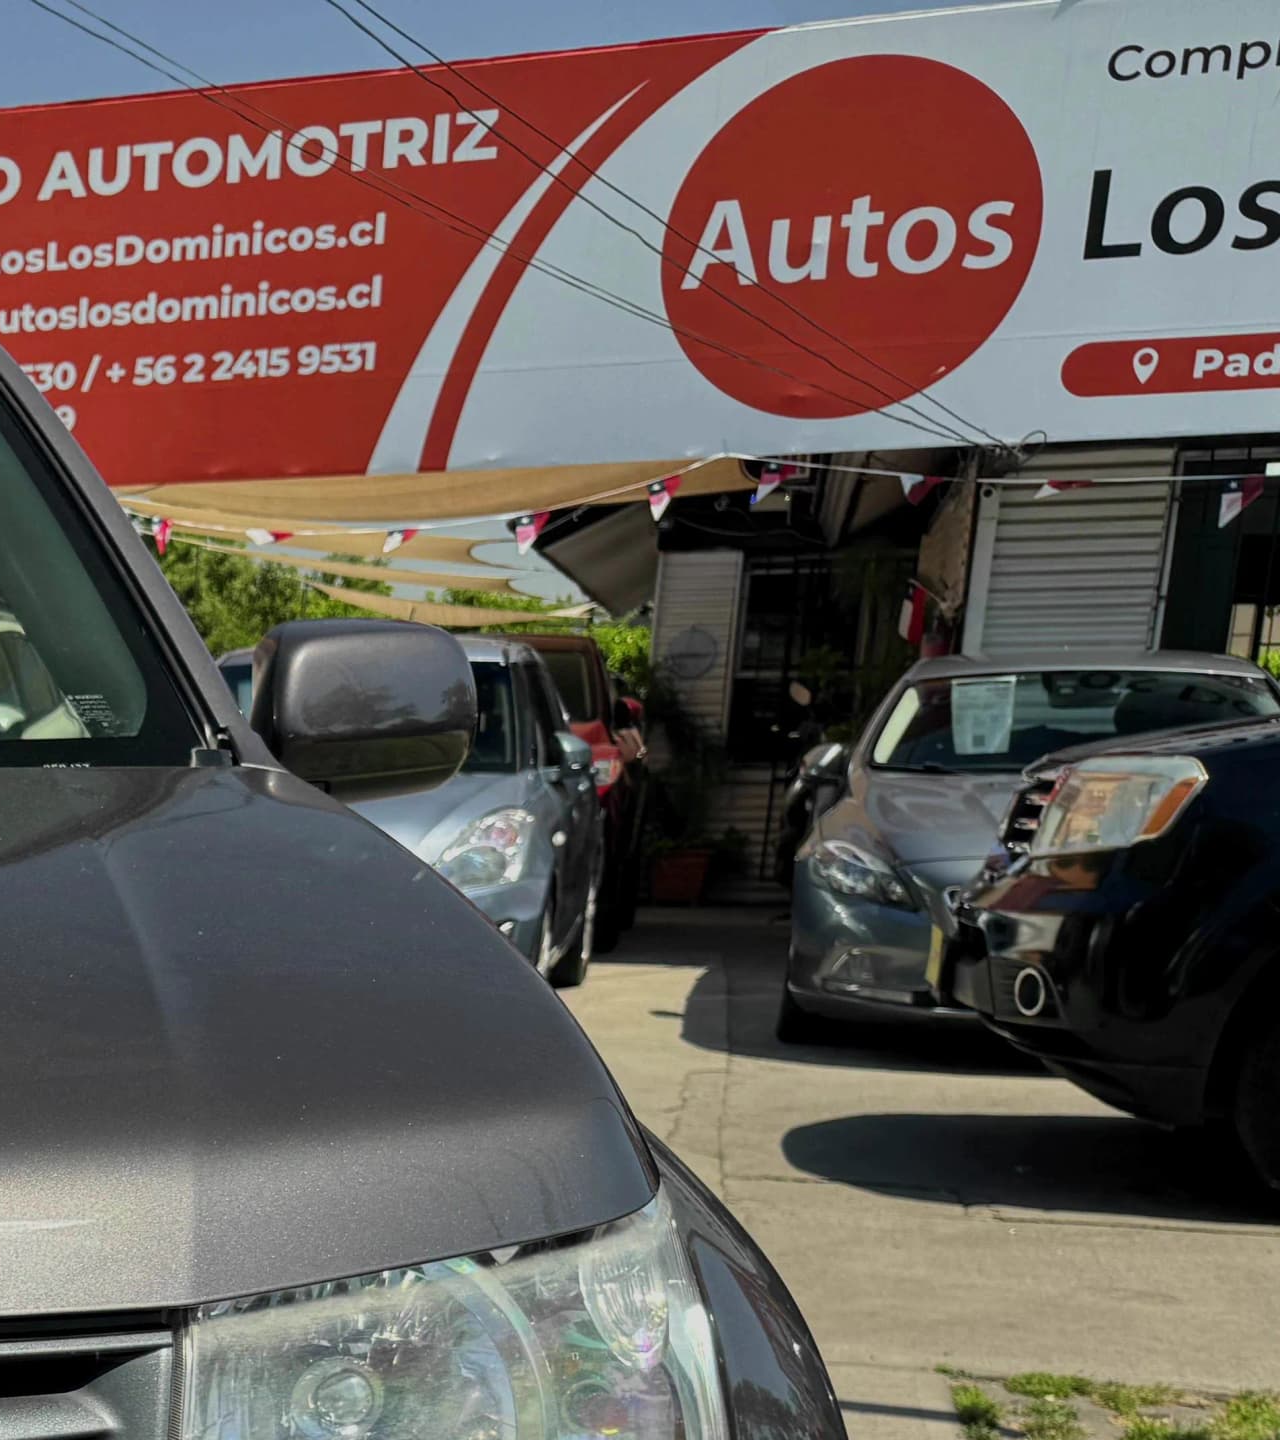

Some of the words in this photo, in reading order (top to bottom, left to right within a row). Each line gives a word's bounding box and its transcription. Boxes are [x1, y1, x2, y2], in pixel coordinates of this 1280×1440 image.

[37, 108, 500, 201] AUTOMOTRIZ
[680, 195, 1016, 290] Autos
[1083, 169, 1280, 260] Los
[132, 355, 177, 387] 56
[182, 353, 205, 383] 2
[211, 347, 290, 382] 2415
[297, 341, 377, 375] 9531
